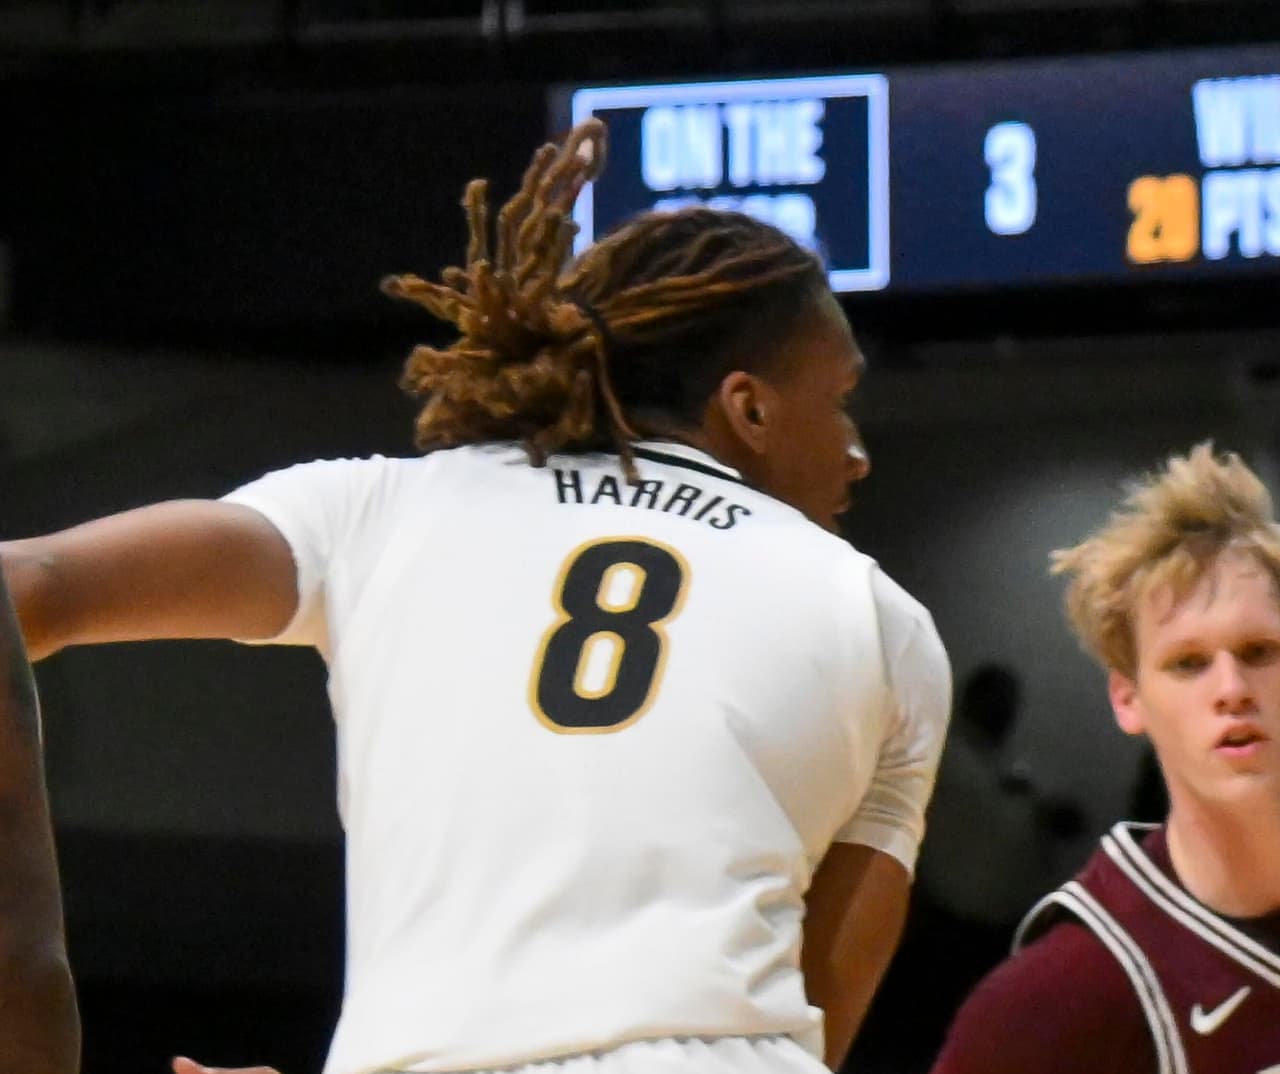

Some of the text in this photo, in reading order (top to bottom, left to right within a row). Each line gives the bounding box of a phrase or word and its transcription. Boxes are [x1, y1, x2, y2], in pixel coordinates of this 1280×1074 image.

[641, 98, 826, 191] ON THE
[984, 121, 1036, 235] 3
[552, 468, 752, 530] HARRIS
[527, 535, 692, 735] 8
